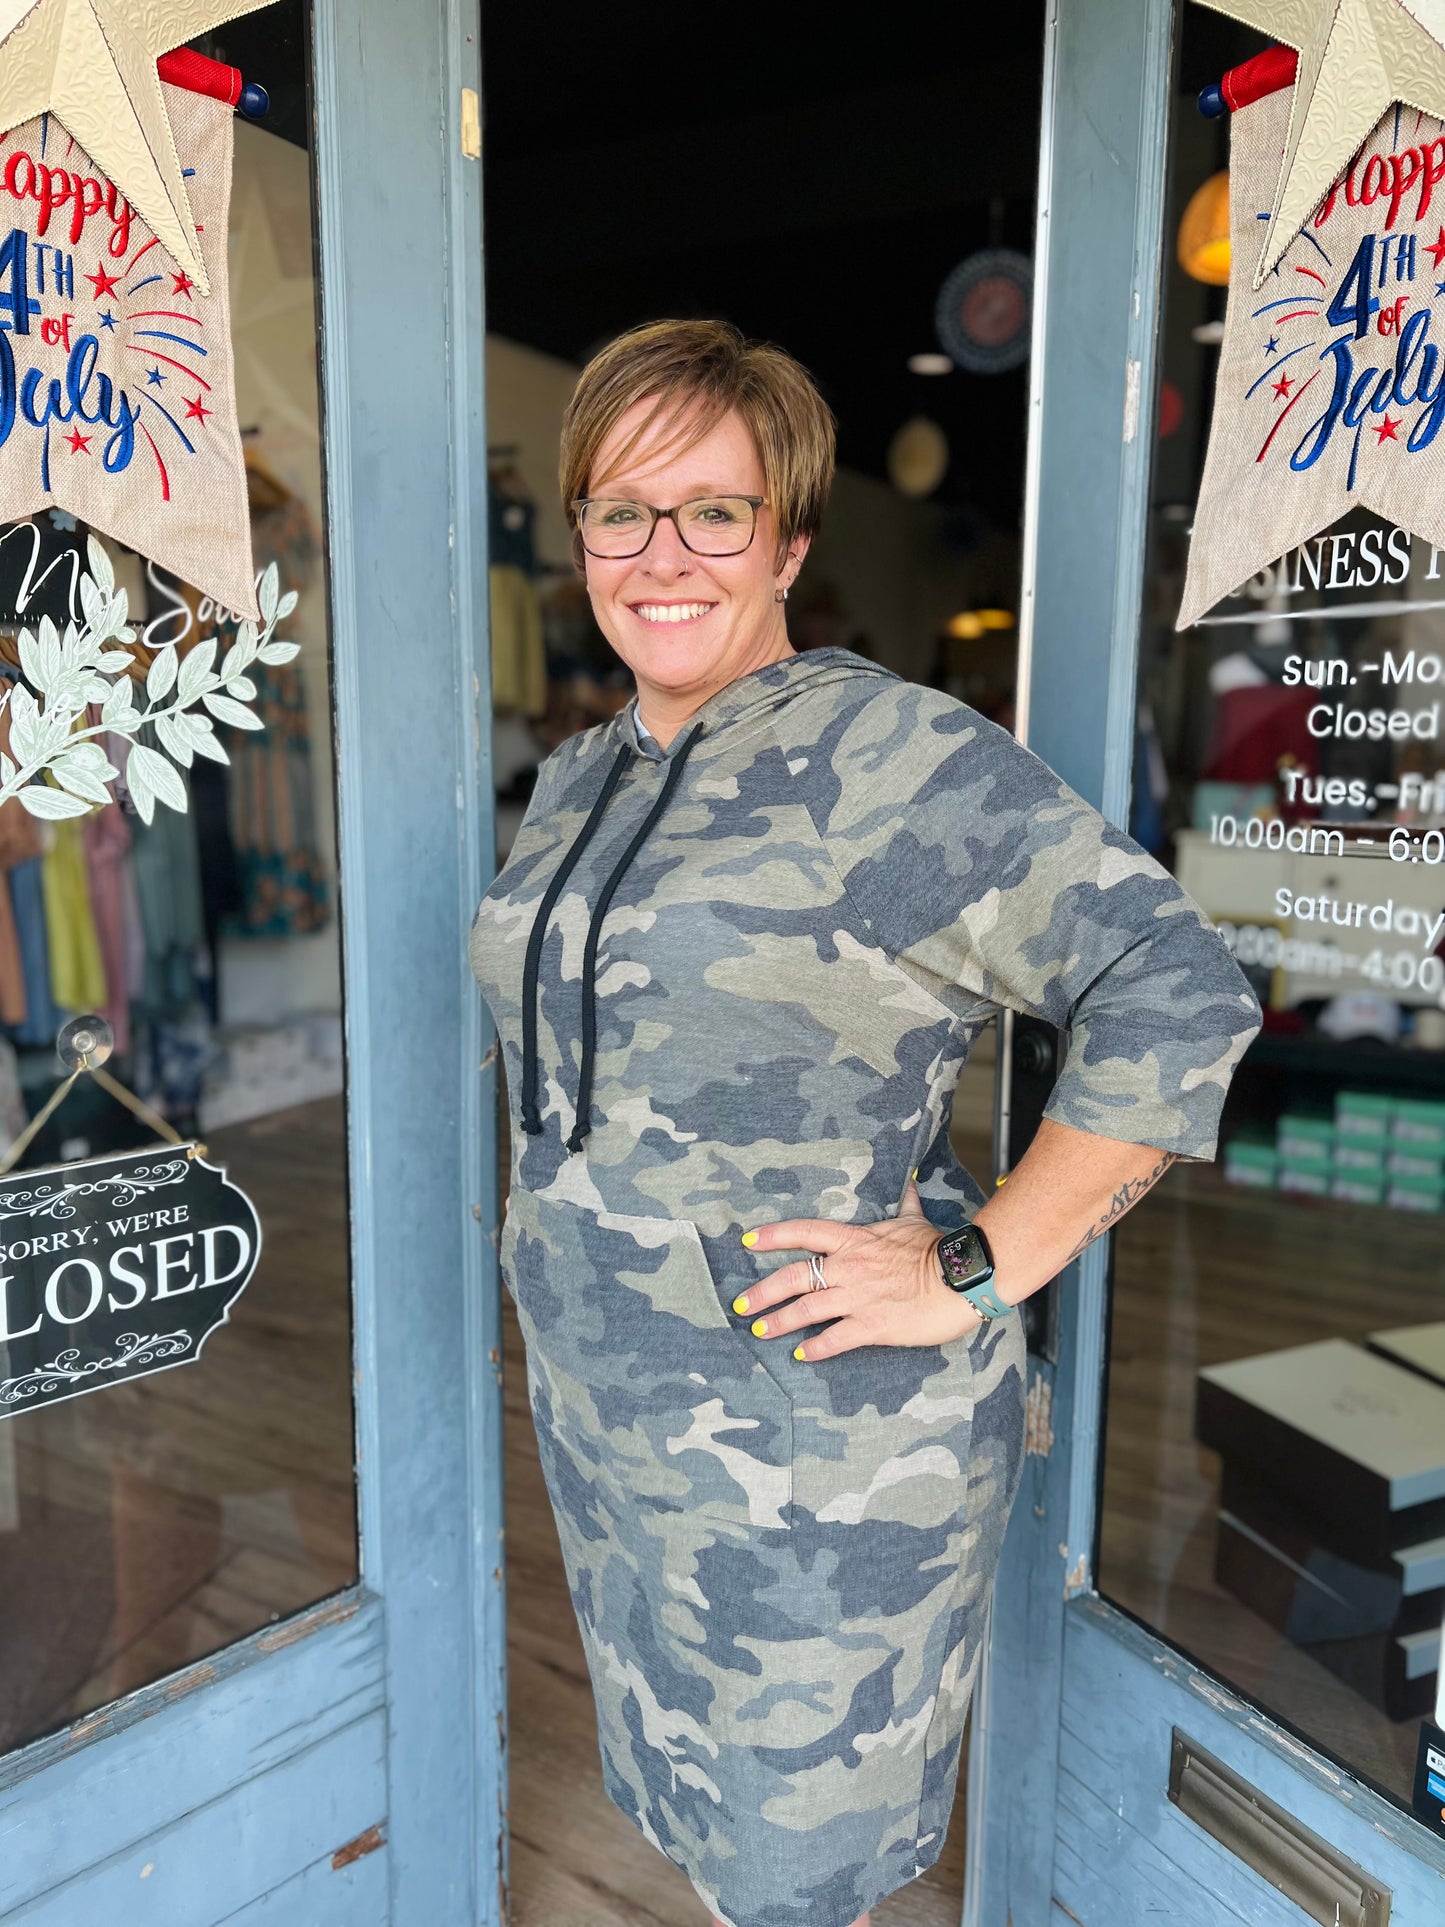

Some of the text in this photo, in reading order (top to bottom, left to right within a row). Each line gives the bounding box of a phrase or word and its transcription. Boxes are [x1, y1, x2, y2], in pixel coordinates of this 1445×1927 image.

[0, 132, 137, 258] appy
[1282, 650, 1445, 687] Sun.-Mo
[1307, 703, 1440, 742] Closed
[1275, 887, 1445, 950] Saturday
[106, 1204, 190, 1238] WE'RE
